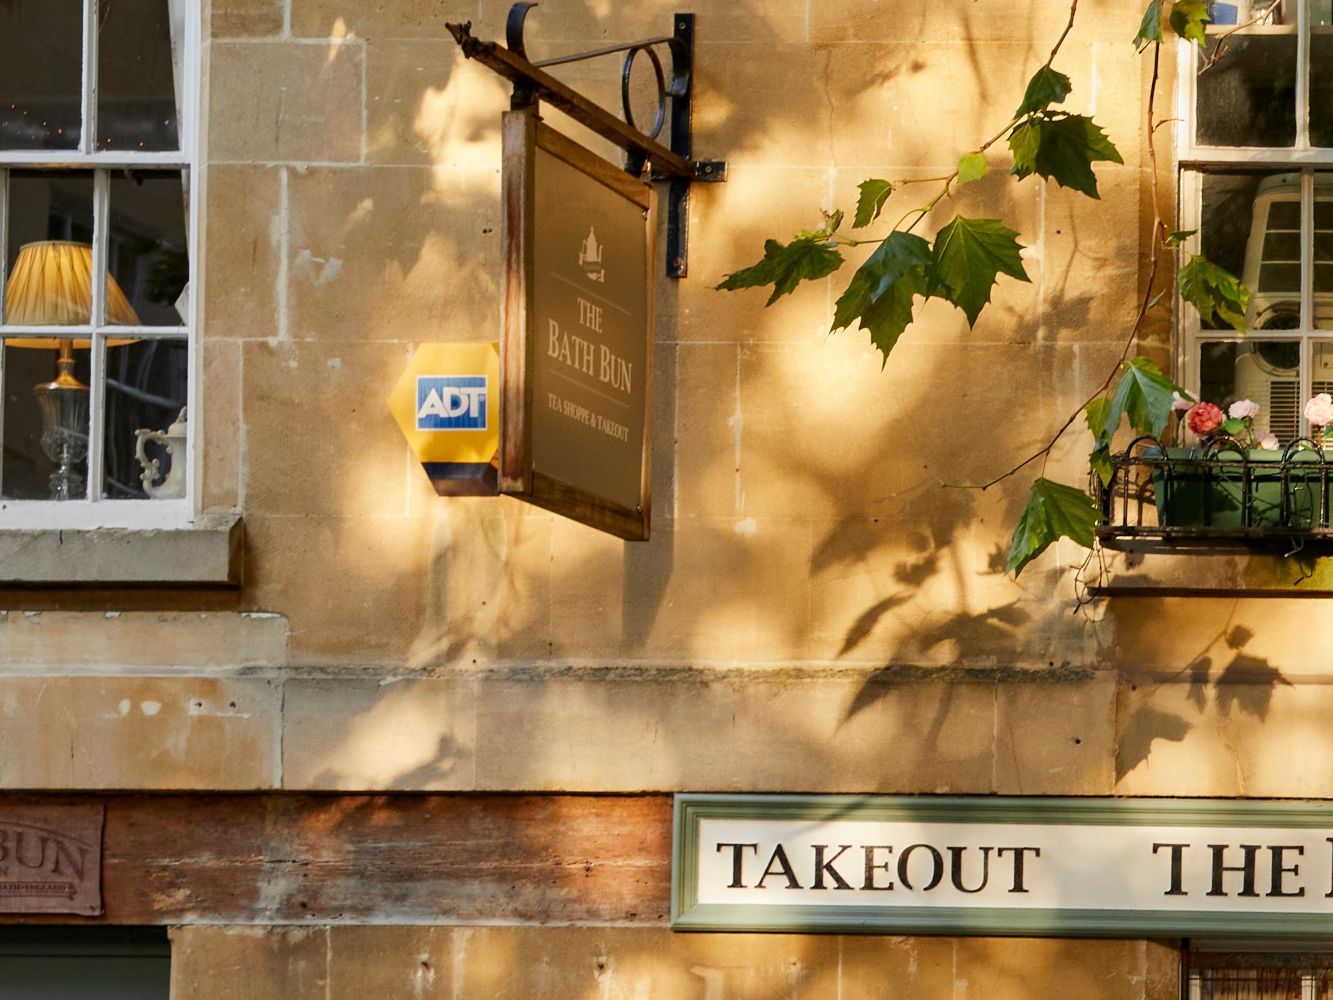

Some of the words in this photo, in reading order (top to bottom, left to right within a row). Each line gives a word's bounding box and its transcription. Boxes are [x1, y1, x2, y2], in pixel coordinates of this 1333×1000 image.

[577, 297, 603, 333] THE
[547, 318, 596, 376] BATH
[599, 344, 633, 394] BUN
[418, 387, 486, 418] ADT
[547, 392, 562, 413] TEA
[563, 400, 590, 425] SHOPPE
[590, 412, 596, 428] &
[597, 415, 629, 443] TAKEOUT
[716, 843, 1041, 893] TAKEOUT
[1152, 842, 1305, 897] THE
